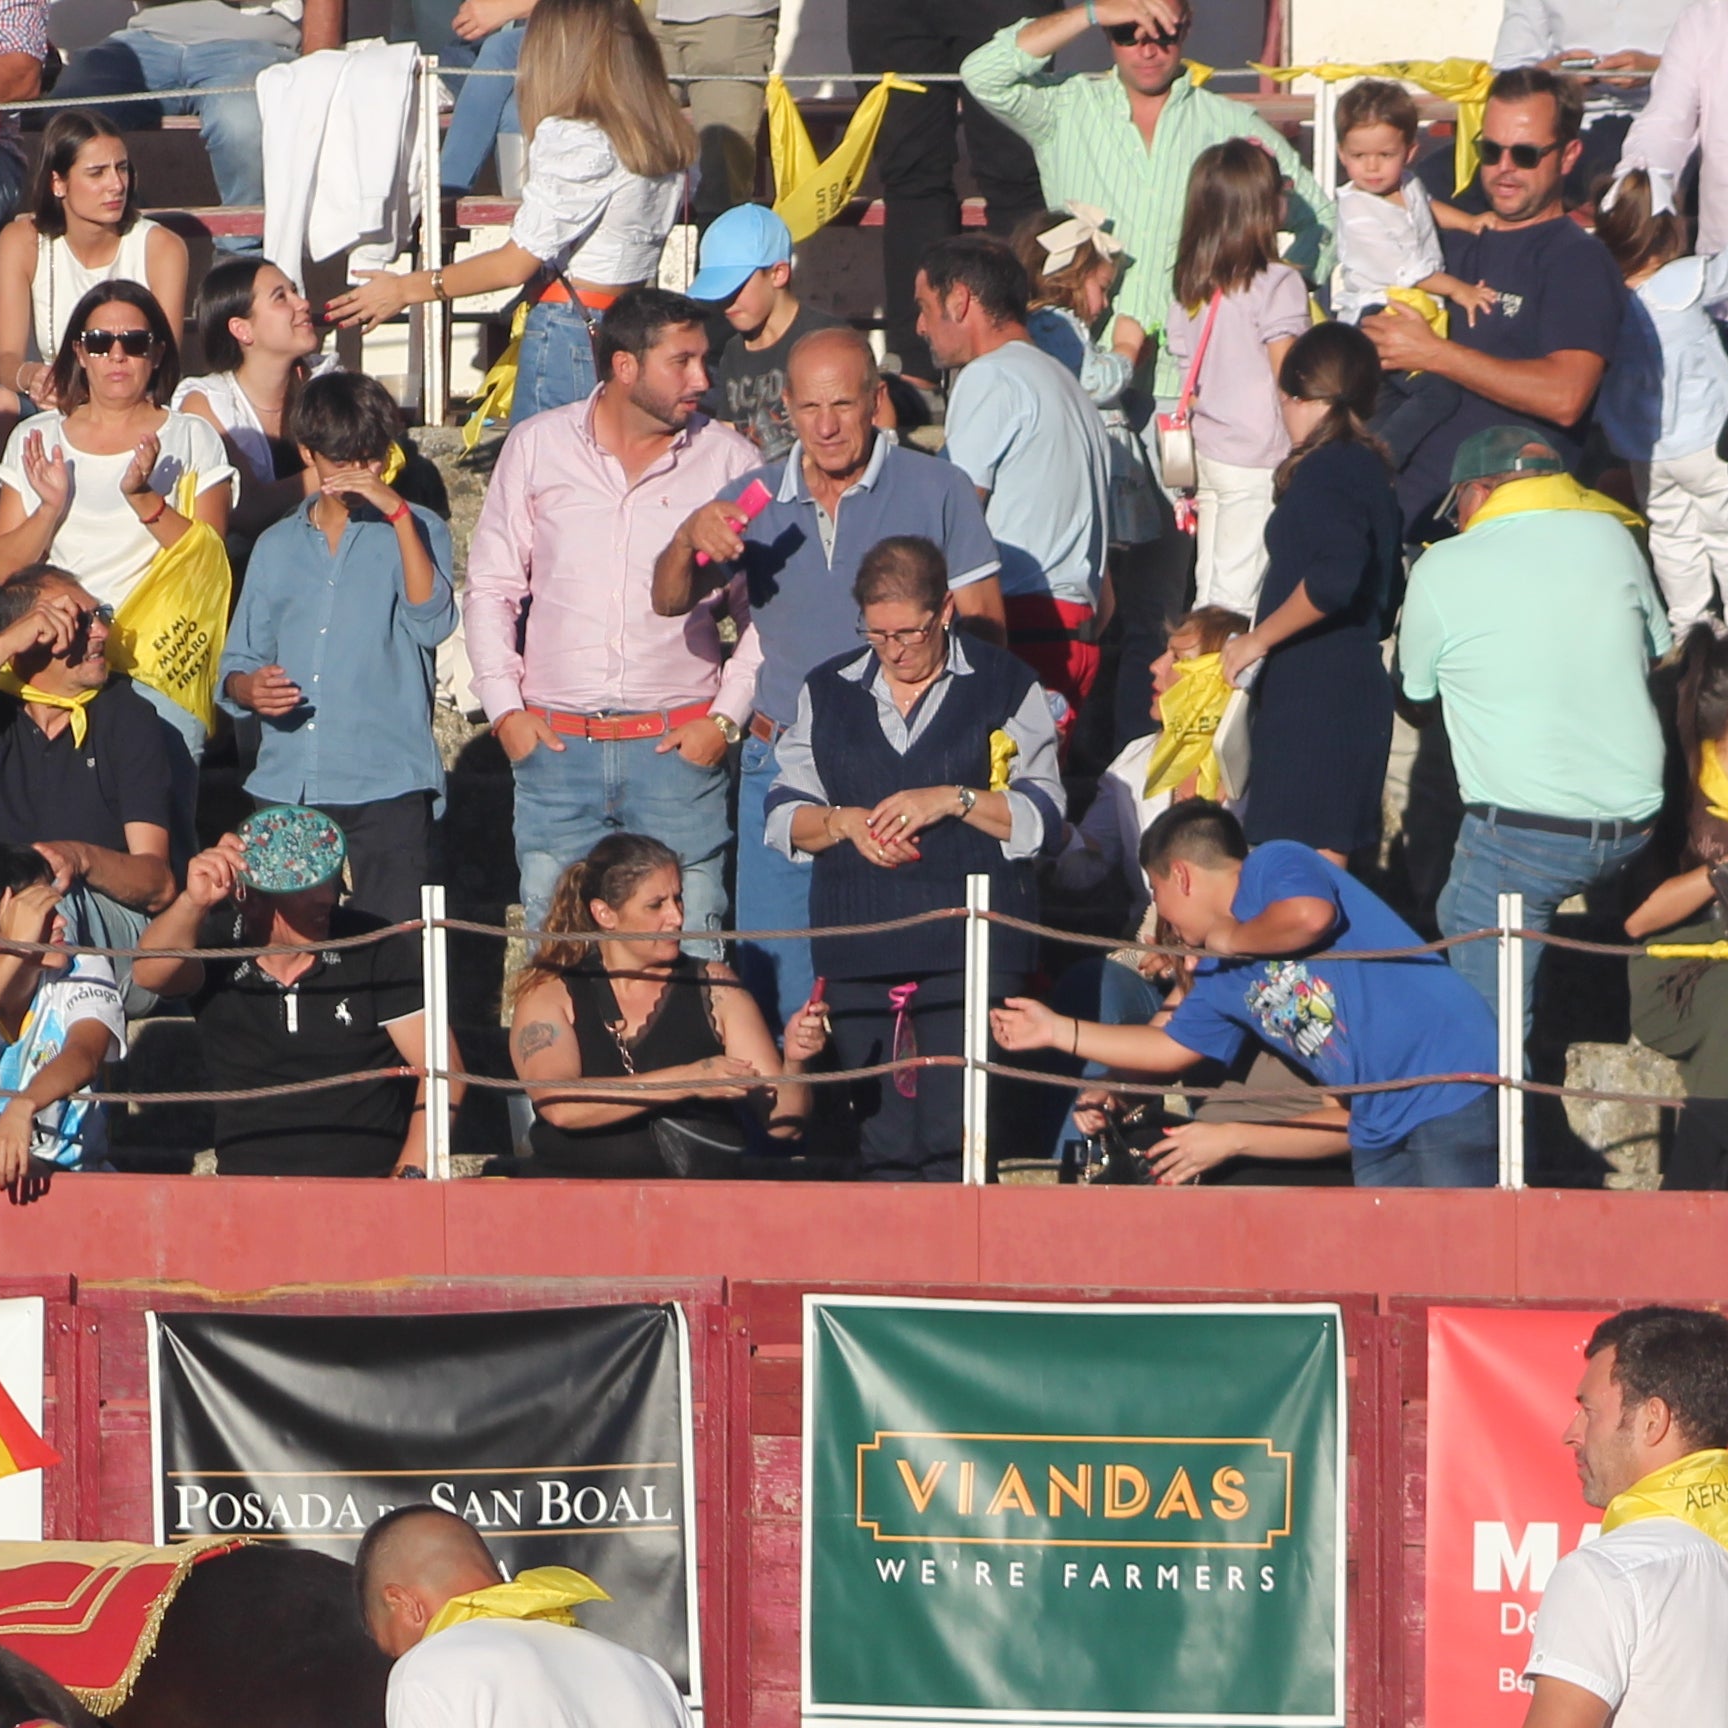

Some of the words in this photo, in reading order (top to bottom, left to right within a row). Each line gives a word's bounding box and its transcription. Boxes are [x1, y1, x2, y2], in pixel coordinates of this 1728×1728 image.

[152, 631, 171, 651] EN
[171, 614, 188, 635] MI
[158, 621, 198, 669] MUNDO
[174, 1485, 365, 1530] POSADA
[535, 1479, 673, 1526] BOAL
[895, 1460, 1250, 1521] VIANDAS
[876, 1557, 1026, 1587] WE'RE
[1063, 1563, 1276, 1592] FARMERS
